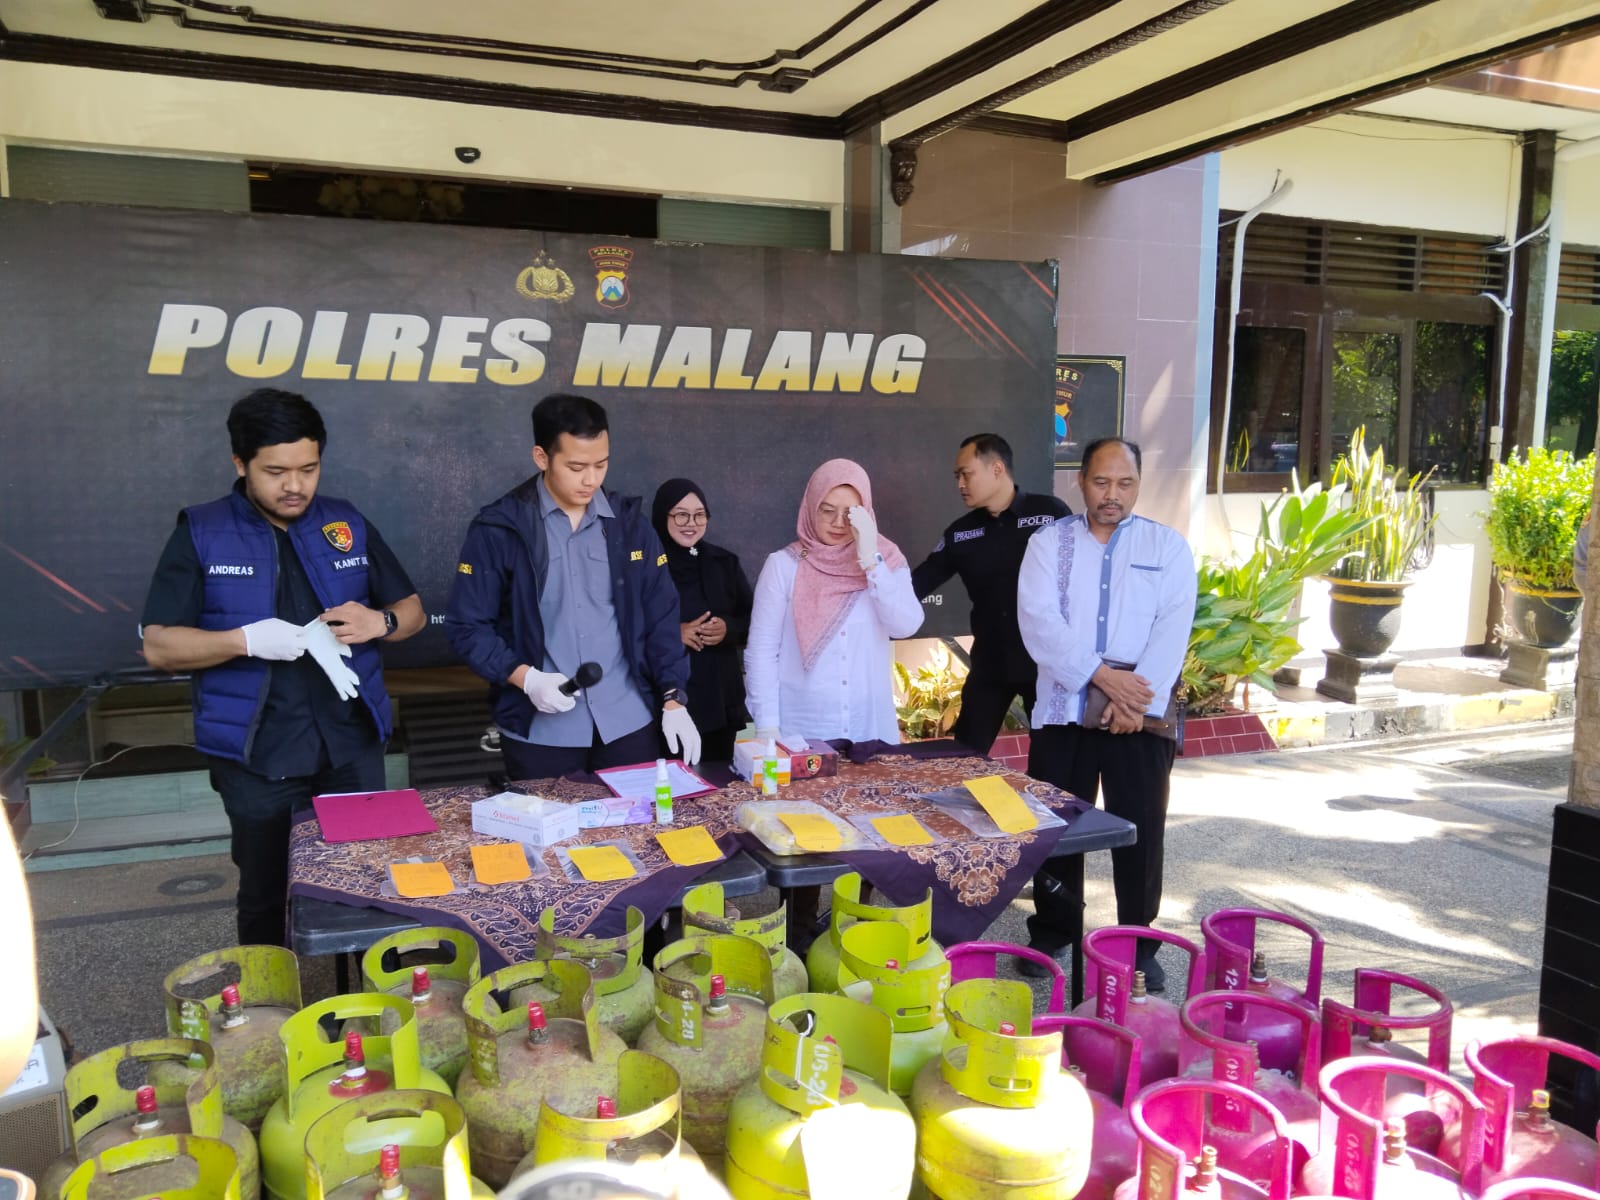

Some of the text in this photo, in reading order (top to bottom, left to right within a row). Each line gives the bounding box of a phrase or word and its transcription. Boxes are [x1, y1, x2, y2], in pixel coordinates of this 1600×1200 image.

[148, 303, 927, 394] POLRES MALANG
[1020, 515, 1054, 527] POLRI
[334, 557, 360, 570] KANIT
[208, 565, 254, 576] ANDREAS
